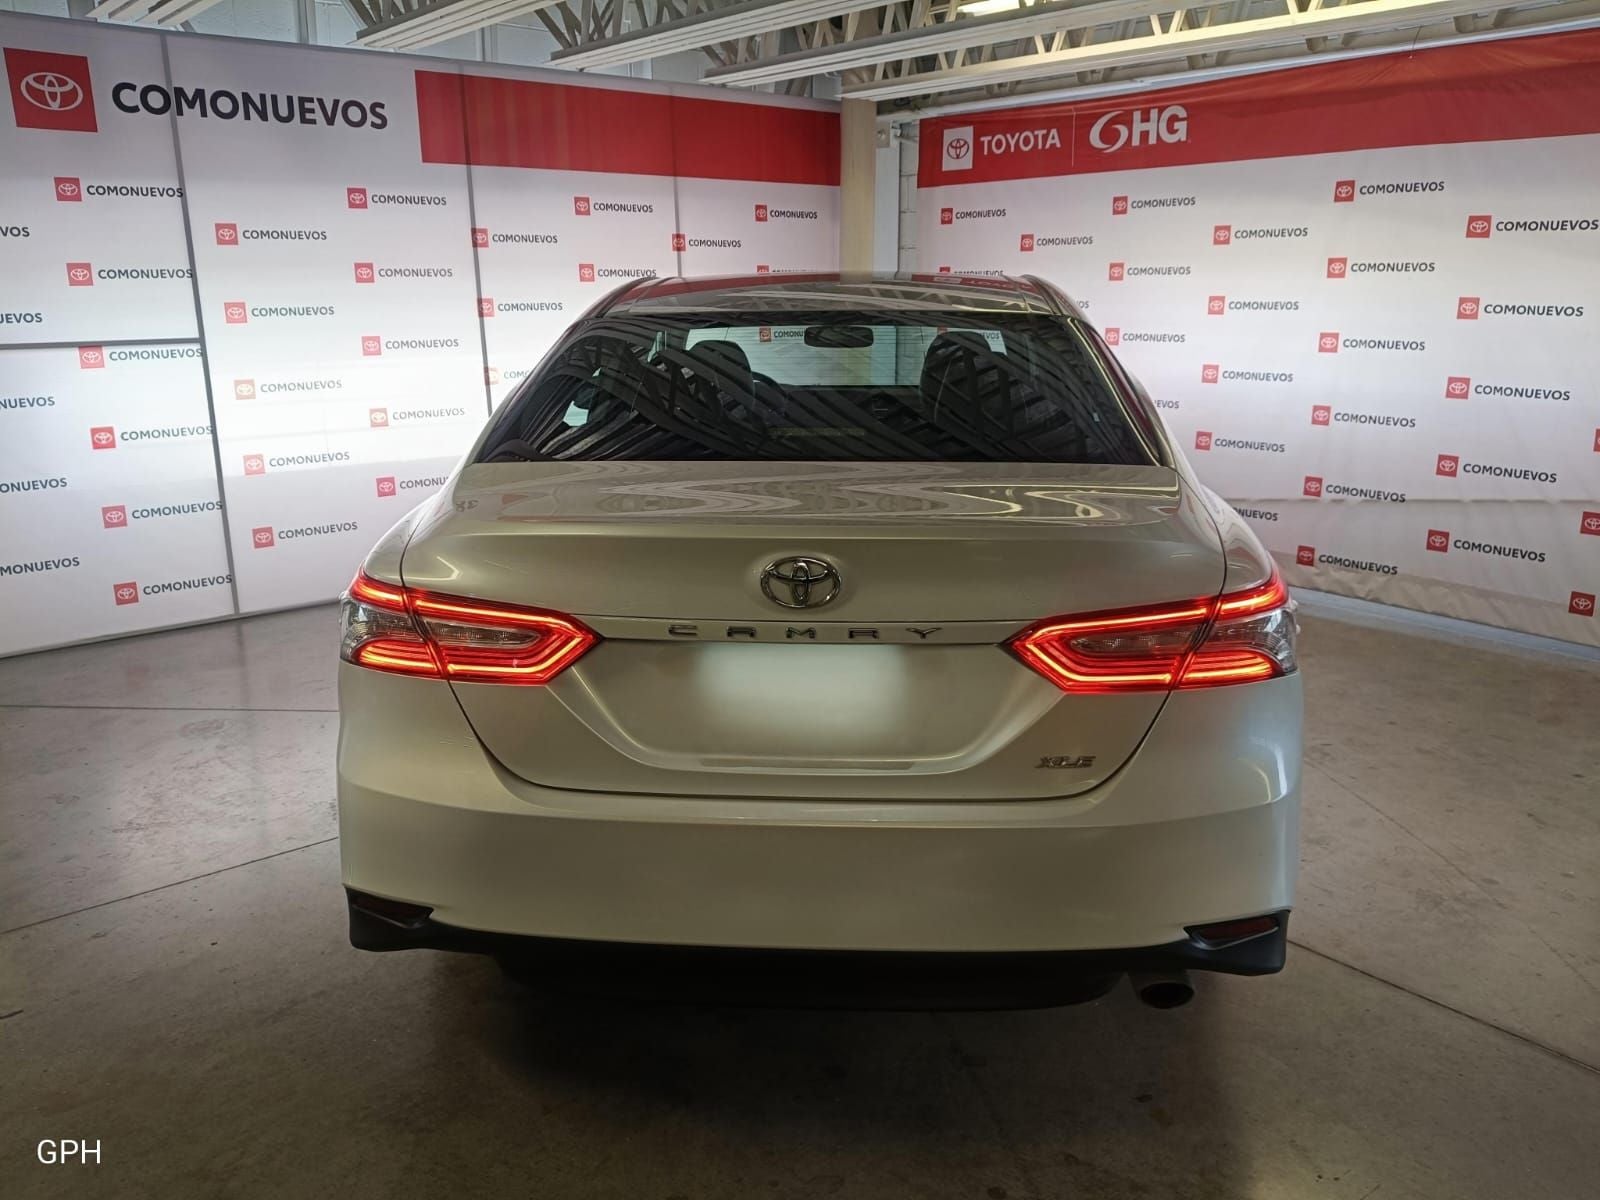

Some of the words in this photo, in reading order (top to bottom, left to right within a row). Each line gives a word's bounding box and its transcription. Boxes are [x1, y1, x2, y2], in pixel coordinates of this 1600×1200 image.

[111, 82, 389, 130] COMONUEVOS
[980, 129, 1061, 155] TOYOTA
[86, 184, 184, 198] COMONUEVOS
[1360, 181, 1444, 195] COMONUEVOS
[372, 194, 446, 205] COMONUEVOS
[1131, 197, 1195, 209] COMONUEVOS
[594, 203, 653, 213] COMONUEVOS
[955, 209, 1006, 219] COMONUEVOS
[770, 210, 817, 219] COMONUEVOS
[1496, 220, 1598, 231] COMONUEVOS
[243, 230, 327, 240] COMONUEVOS
[492, 234, 557, 243] COMONUEVOS
[1235, 228, 1308, 238] COMONUEVOS
[689, 239, 741, 248] COMONUEVOS
[1037, 236, 1093, 246] COMONUEVOS
[378, 268, 452, 277] COMONUEVOS
[597, 268, 657, 278] COMONUEVOS
[1127, 266, 1190, 276] COMONUEVOS
[1351, 262, 1435, 272] COMONUEVOS
[98, 268, 193, 280] COMONUEVOS
[251, 306, 334, 317] COMONUEVOS
[498, 303, 562, 311] COMONUEVOS
[1229, 301, 1299, 310] COMONUEVOS
[1484, 304, 1583, 317] COMONUEVOS
[1123, 333, 1185, 342] COMONUEVOS
[386, 339, 459, 349] COMONUEVOS
[1343, 339, 1425, 351] COMONUEVOS
[109, 347, 203, 361] COMONUEVOS
[1222, 371, 1293, 382] COMONUEVOS
[260, 380, 342, 392] COMONUEVOS
[1475, 385, 1570, 400] COMONUEVOS
[393, 408, 464, 420] COMONUEVOS
[1334, 413, 1415, 428] COMONUEVOS
[120, 425, 214, 441] COMONUEVOS
[1215, 439, 1285, 452] COMONUEVOS
[269, 452, 350, 467] COMONUEVOS
[1463, 464, 1556, 483] COMONUEVOS
[398, 476, 451, 490] COMONU
[1325, 483, 1407, 502] COMONUEVOS
[131, 501, 224, 519] COMONUEVOS
[278, 522, 358, 539] COMONUEVOS
[1454, 540, 1545, 562] COMONUEVOS
[1319, 555, 1398, 575] COMONUEVOS
[142, 574, 233, 595] COMONUEVOS
[668, 624, 943, 640] CAMRY
[1036, 755, 1096, 769] XLE
